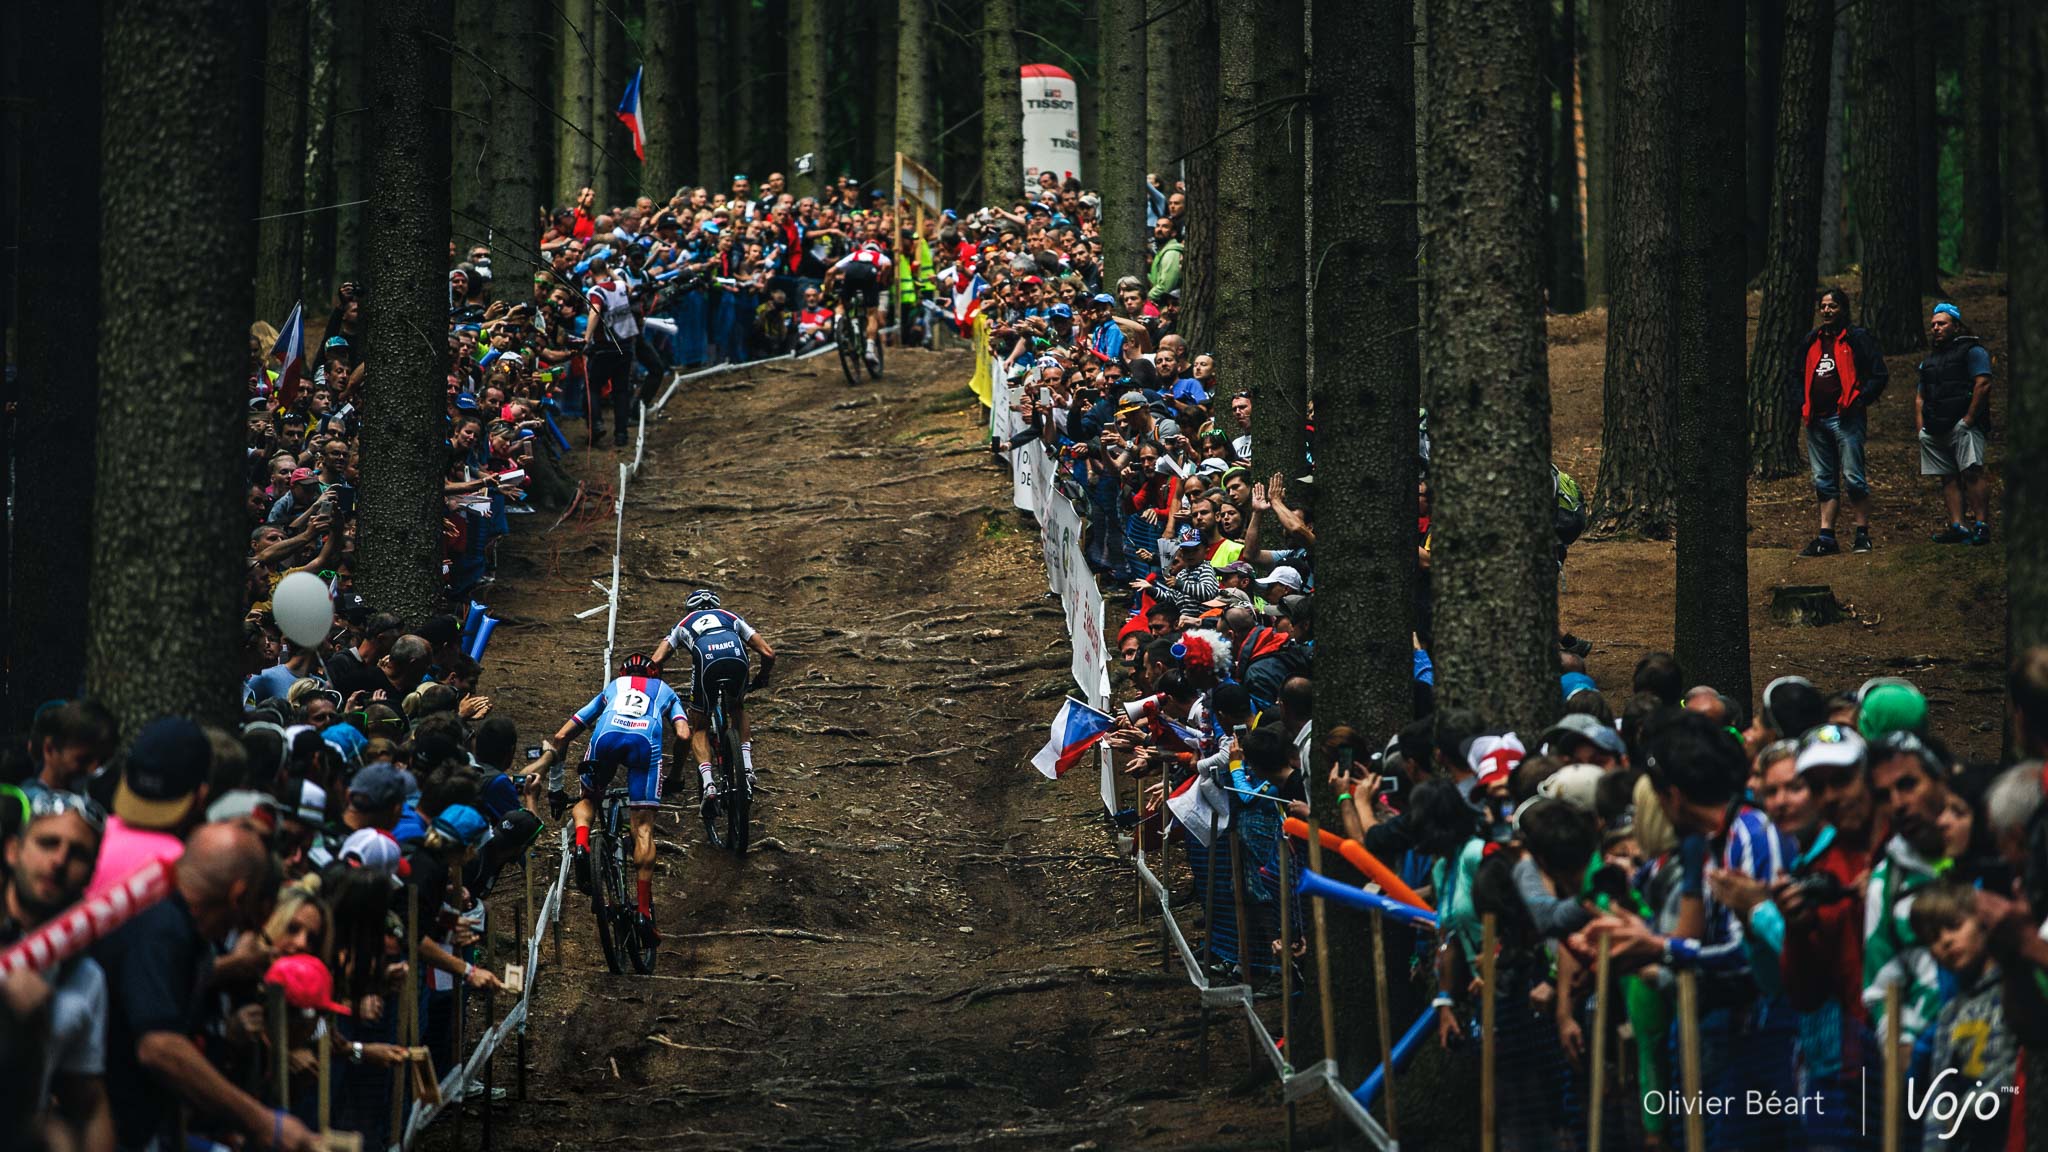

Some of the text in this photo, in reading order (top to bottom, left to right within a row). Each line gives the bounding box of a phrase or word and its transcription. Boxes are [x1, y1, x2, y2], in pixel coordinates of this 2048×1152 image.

[1027, 99, 1074, 110] TISSOT
[700, 618, 709, 626] 2
[712, 640, 735, 651] FRANCE
[625, 694, 643, 708] 12
